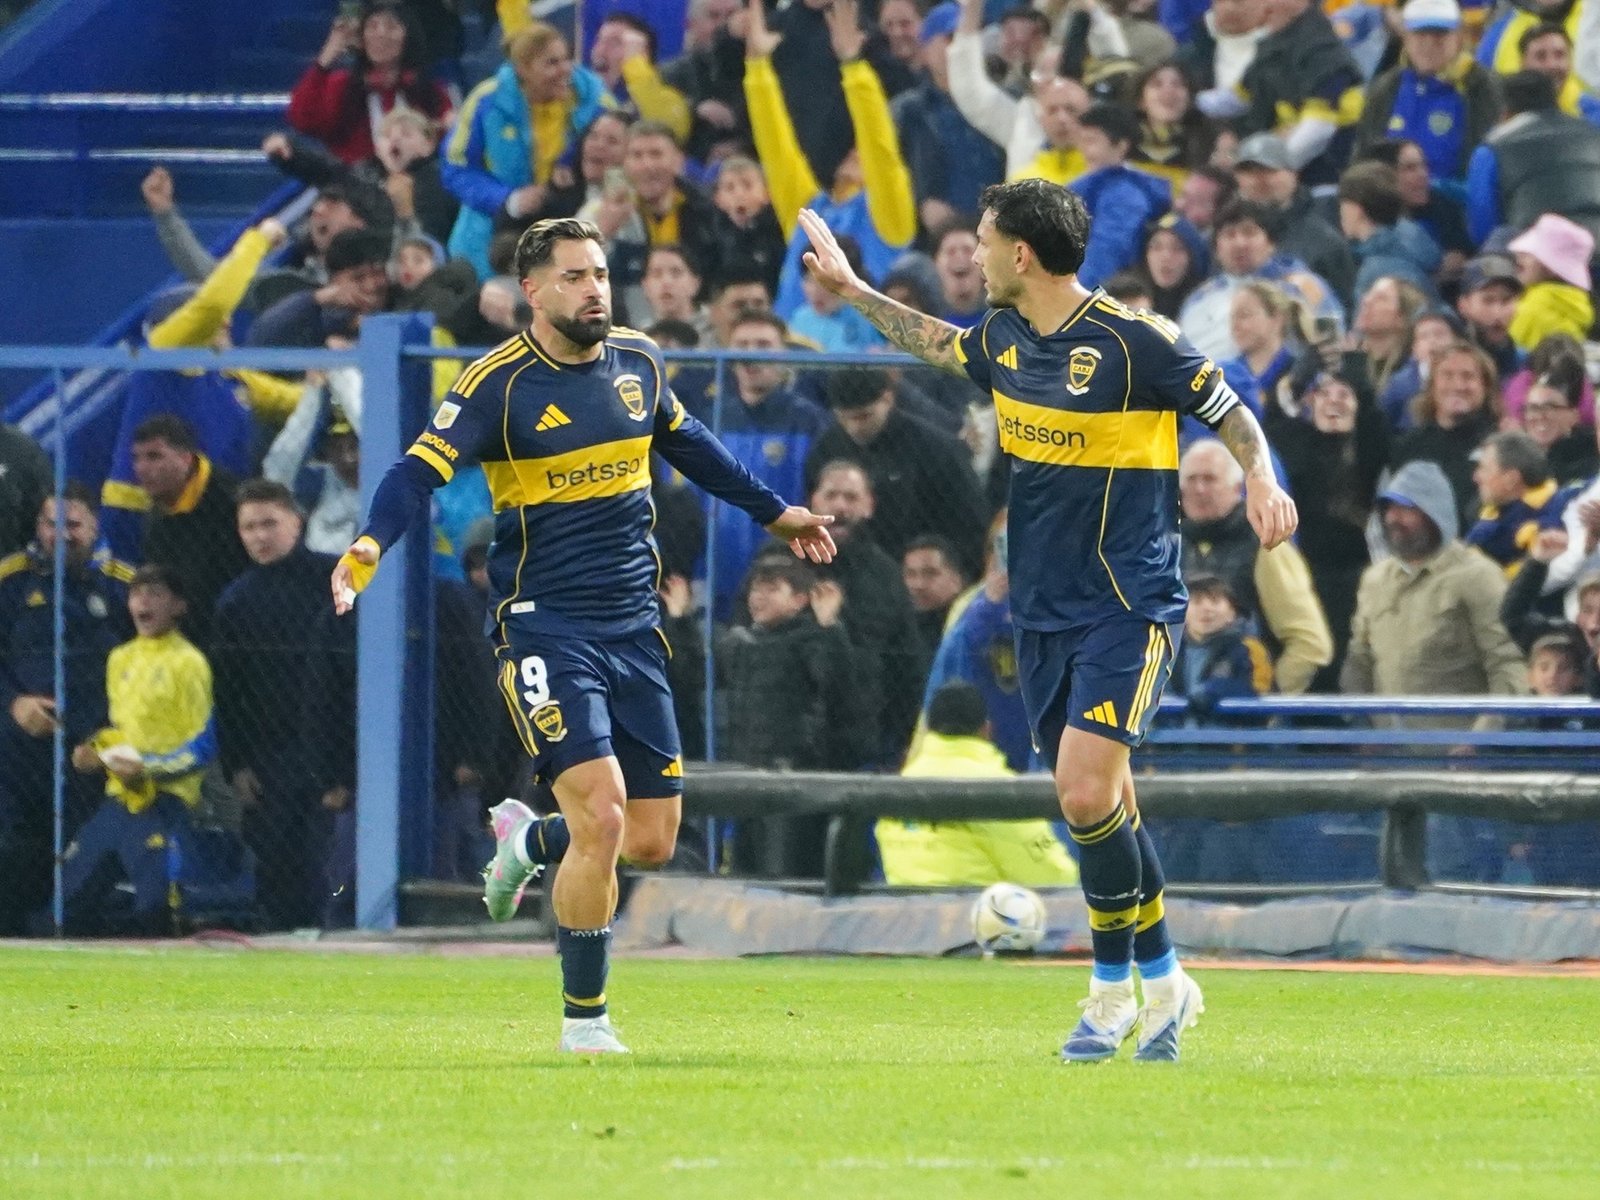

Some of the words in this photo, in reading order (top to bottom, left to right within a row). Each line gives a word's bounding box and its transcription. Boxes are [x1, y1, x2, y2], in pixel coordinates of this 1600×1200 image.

[1073, 364, 1091, 374] CABJ
[1190, 359, 1215, 392] CETR
[416, 432, 459, 461] ROGAR
[546, 456, 645, 489] betsso
[520, 655, 550, 706] 9
